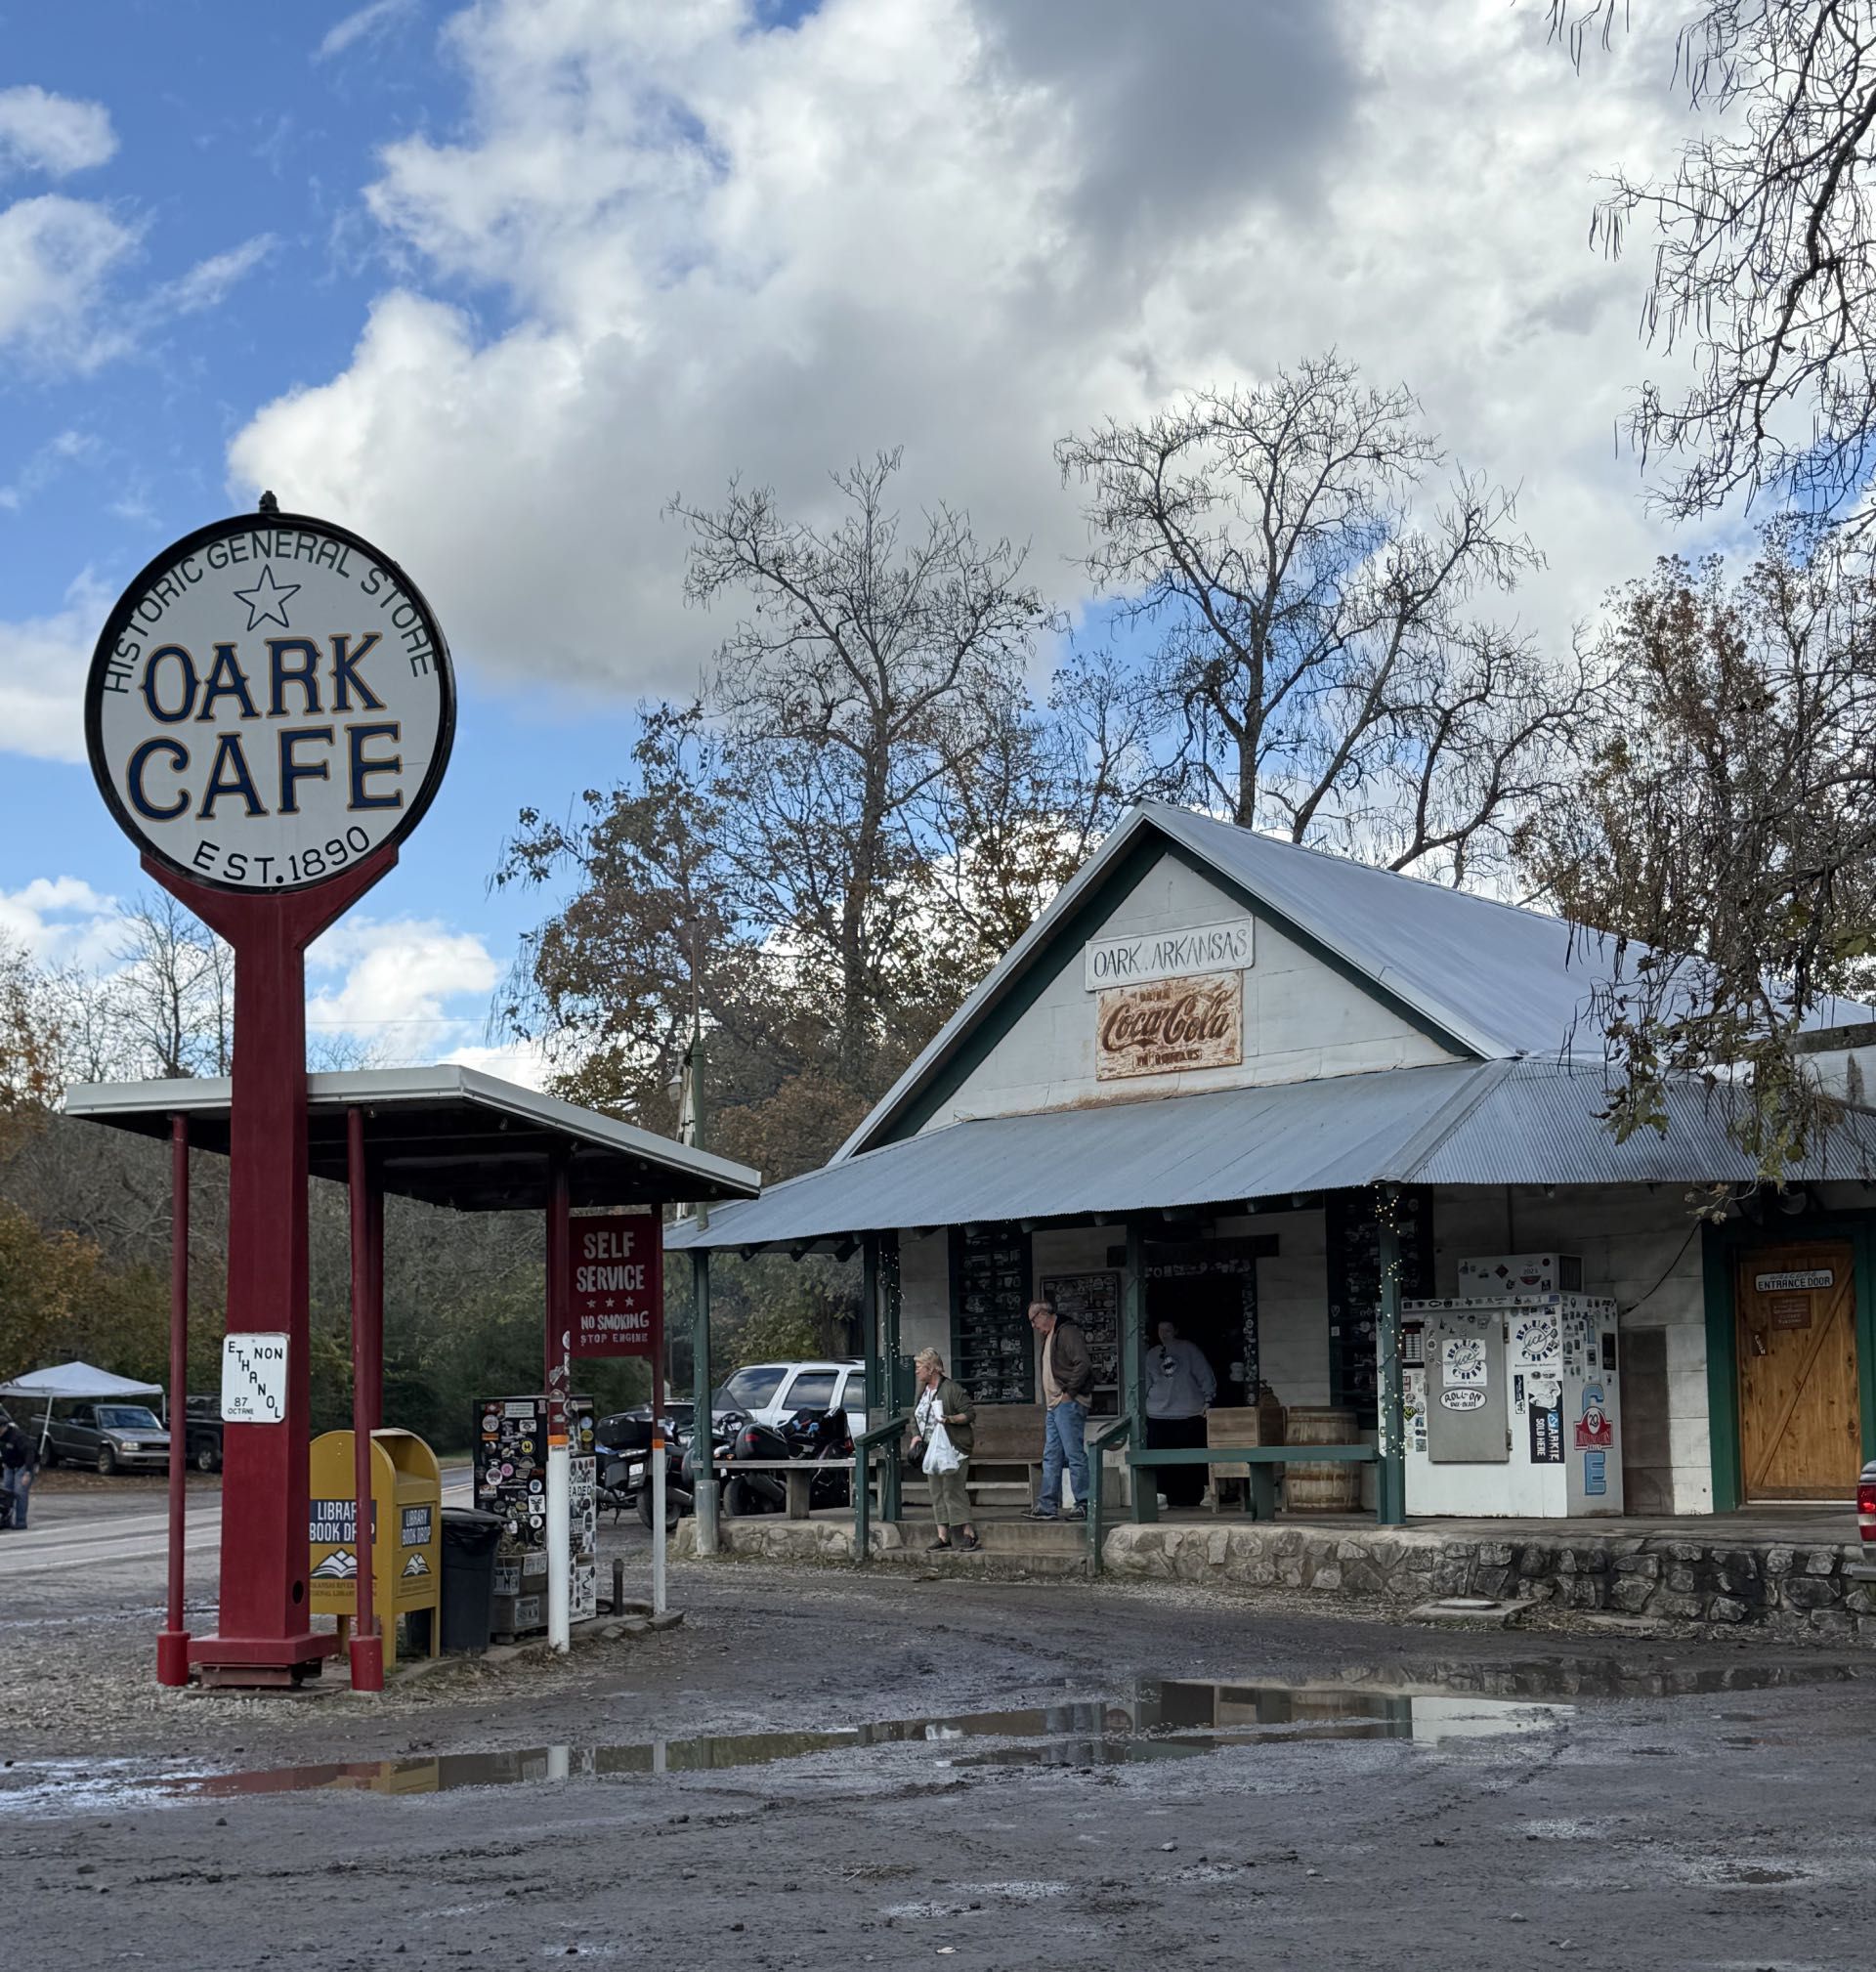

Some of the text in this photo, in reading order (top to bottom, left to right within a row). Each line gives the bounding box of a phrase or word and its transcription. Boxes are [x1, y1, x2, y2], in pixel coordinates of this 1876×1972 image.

[104, 531, 439, 693] HISTORIC GENERAL STORE
[138, 632, 387, 725] OARK
[125, 721, 405, 823] CAFE
[1151, 928, 1248, 970] ARKANSAS
[583, 1231, 635, 1260] SELF
[576, 1265, 645, 1293] SERVICE
[1759, 1276, 1830, 1291] ENTRANCE DOOR
[580, 1310, 650, 1330] NO SMOKING
[1515, 1319, 1552, 1341] BLUE
[580, 1333, 648, 1345] STOP ENGINE
[254, 1348, 283, 1359] NON
[228, 1341, 281, 1419] ETHANOL
[234, 1397, 248, 1407] 87
[1535, 1418, 1546, 1456] SOLD HERE
[405, 1508, 429, 1527] LIBRARY
[309, 1522, 340, 1542] BOOK
